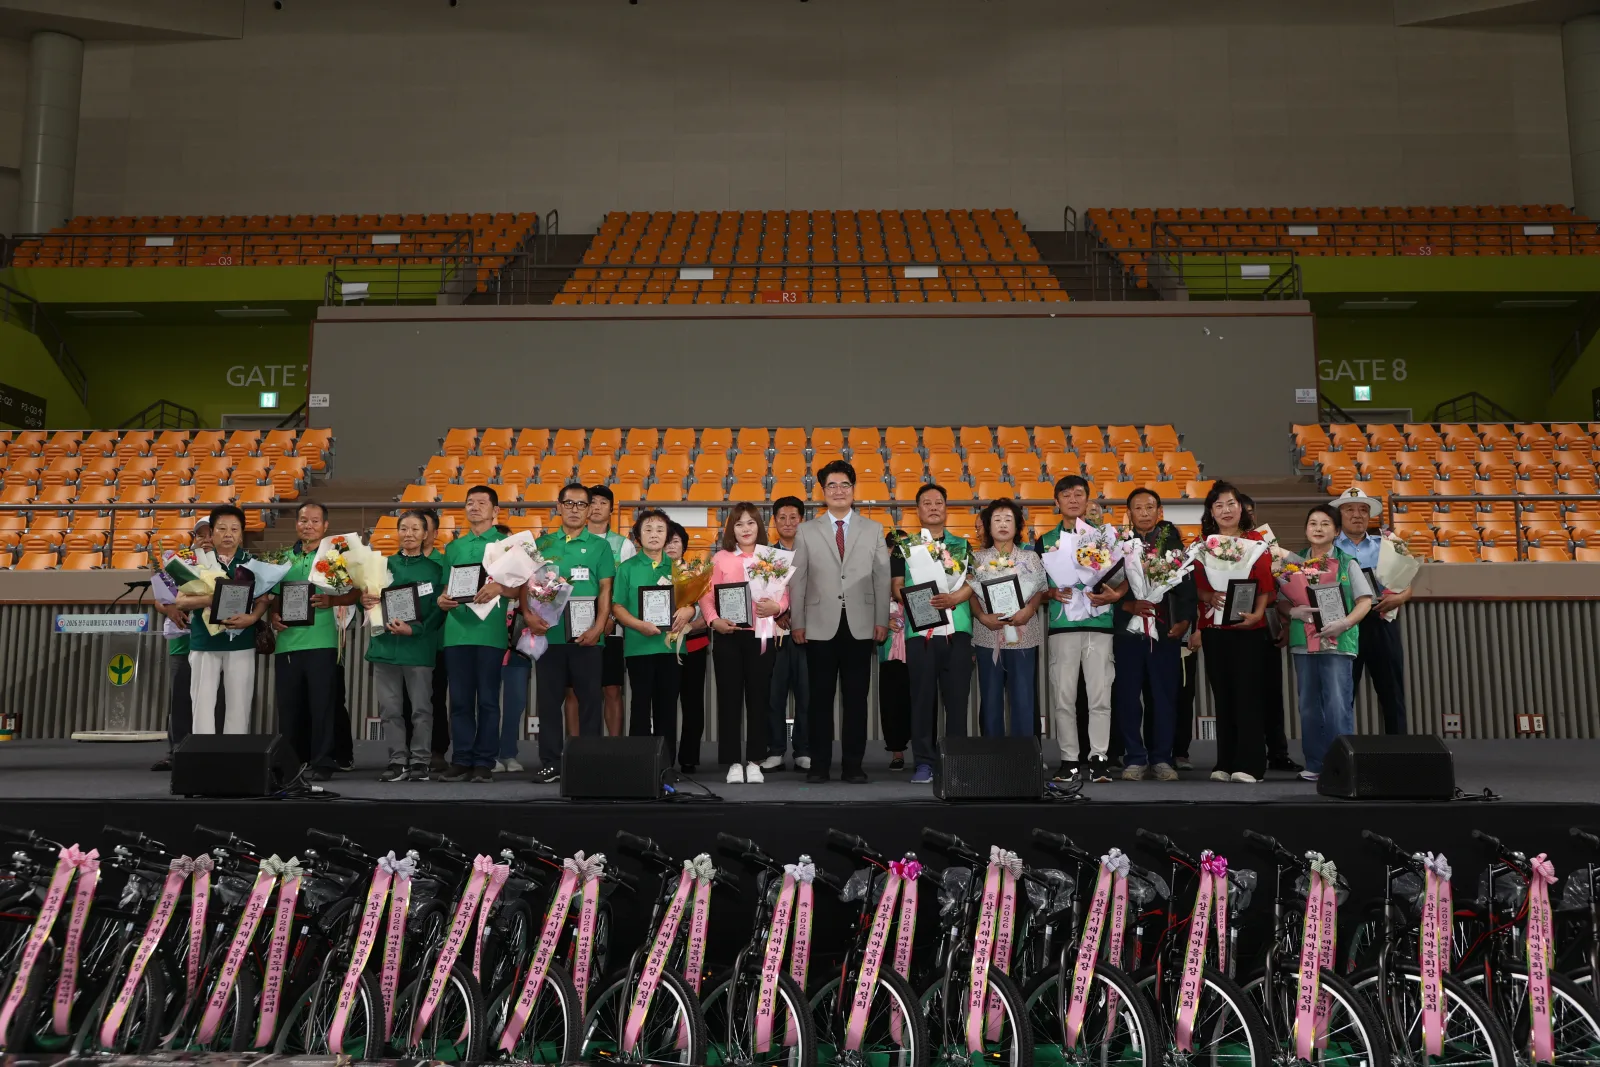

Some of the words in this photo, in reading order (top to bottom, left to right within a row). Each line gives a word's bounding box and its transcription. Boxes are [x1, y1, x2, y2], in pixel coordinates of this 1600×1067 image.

[218, 256, 232, 266] Q3
[1419, 246, 1432, 256] S3
[782, 292, 796, 302] R3
[226, 365, 296, 386] GATE
[1318, 359, 1386, 380] GATE
[1392, 358, 1408, 381] 8
[74, 900, 86, 925] 2026
[279, 907, 290, 932] 2026
[392, 906, 402, 931] 2026
[582, 908, 591, 932] 2026
[695, 908, 704, 934] 2026
[902, 908, 912, 932] 2026
[1002, 904, 1011, 929] 2026
[1115, 904, 1124, 928] 2026
